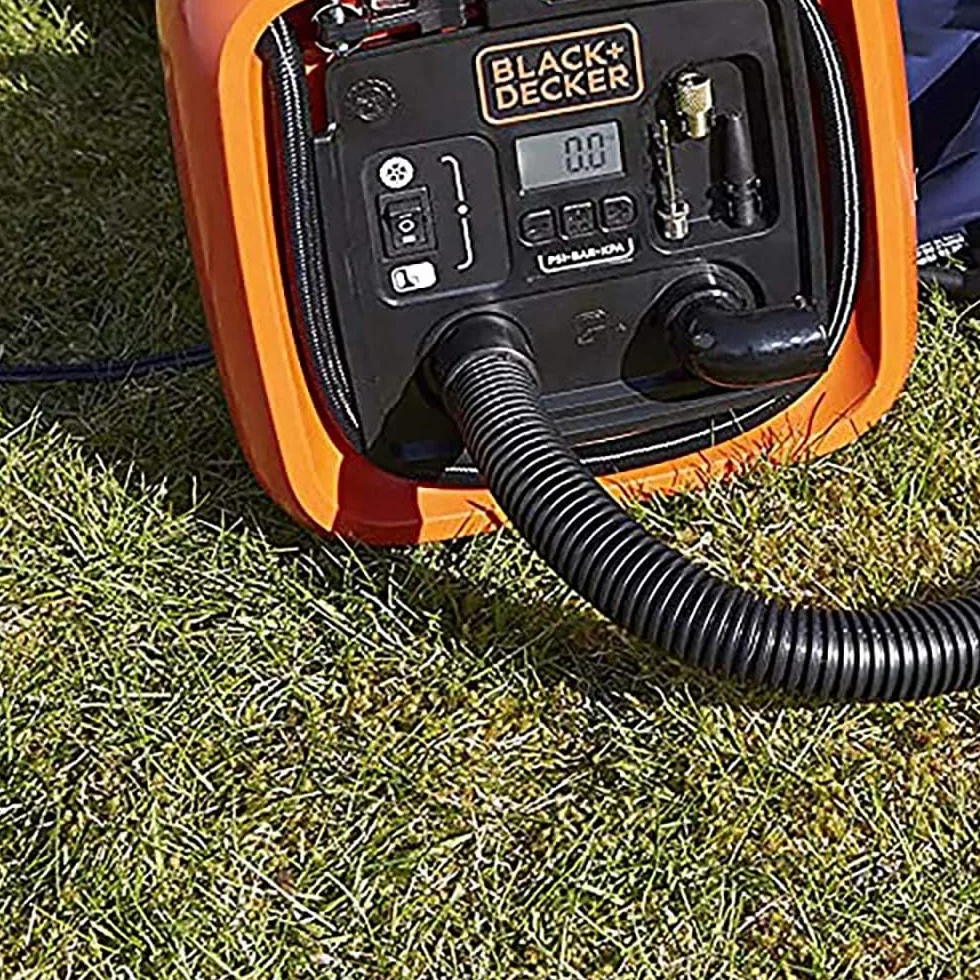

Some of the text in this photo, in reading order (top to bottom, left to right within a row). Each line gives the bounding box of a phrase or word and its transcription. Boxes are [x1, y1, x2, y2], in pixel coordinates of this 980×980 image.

[491, 40, 625, 84] BLACK+
[496, 63, 631, 110] DECKER
[565, 132, 606, 173] 0.0
